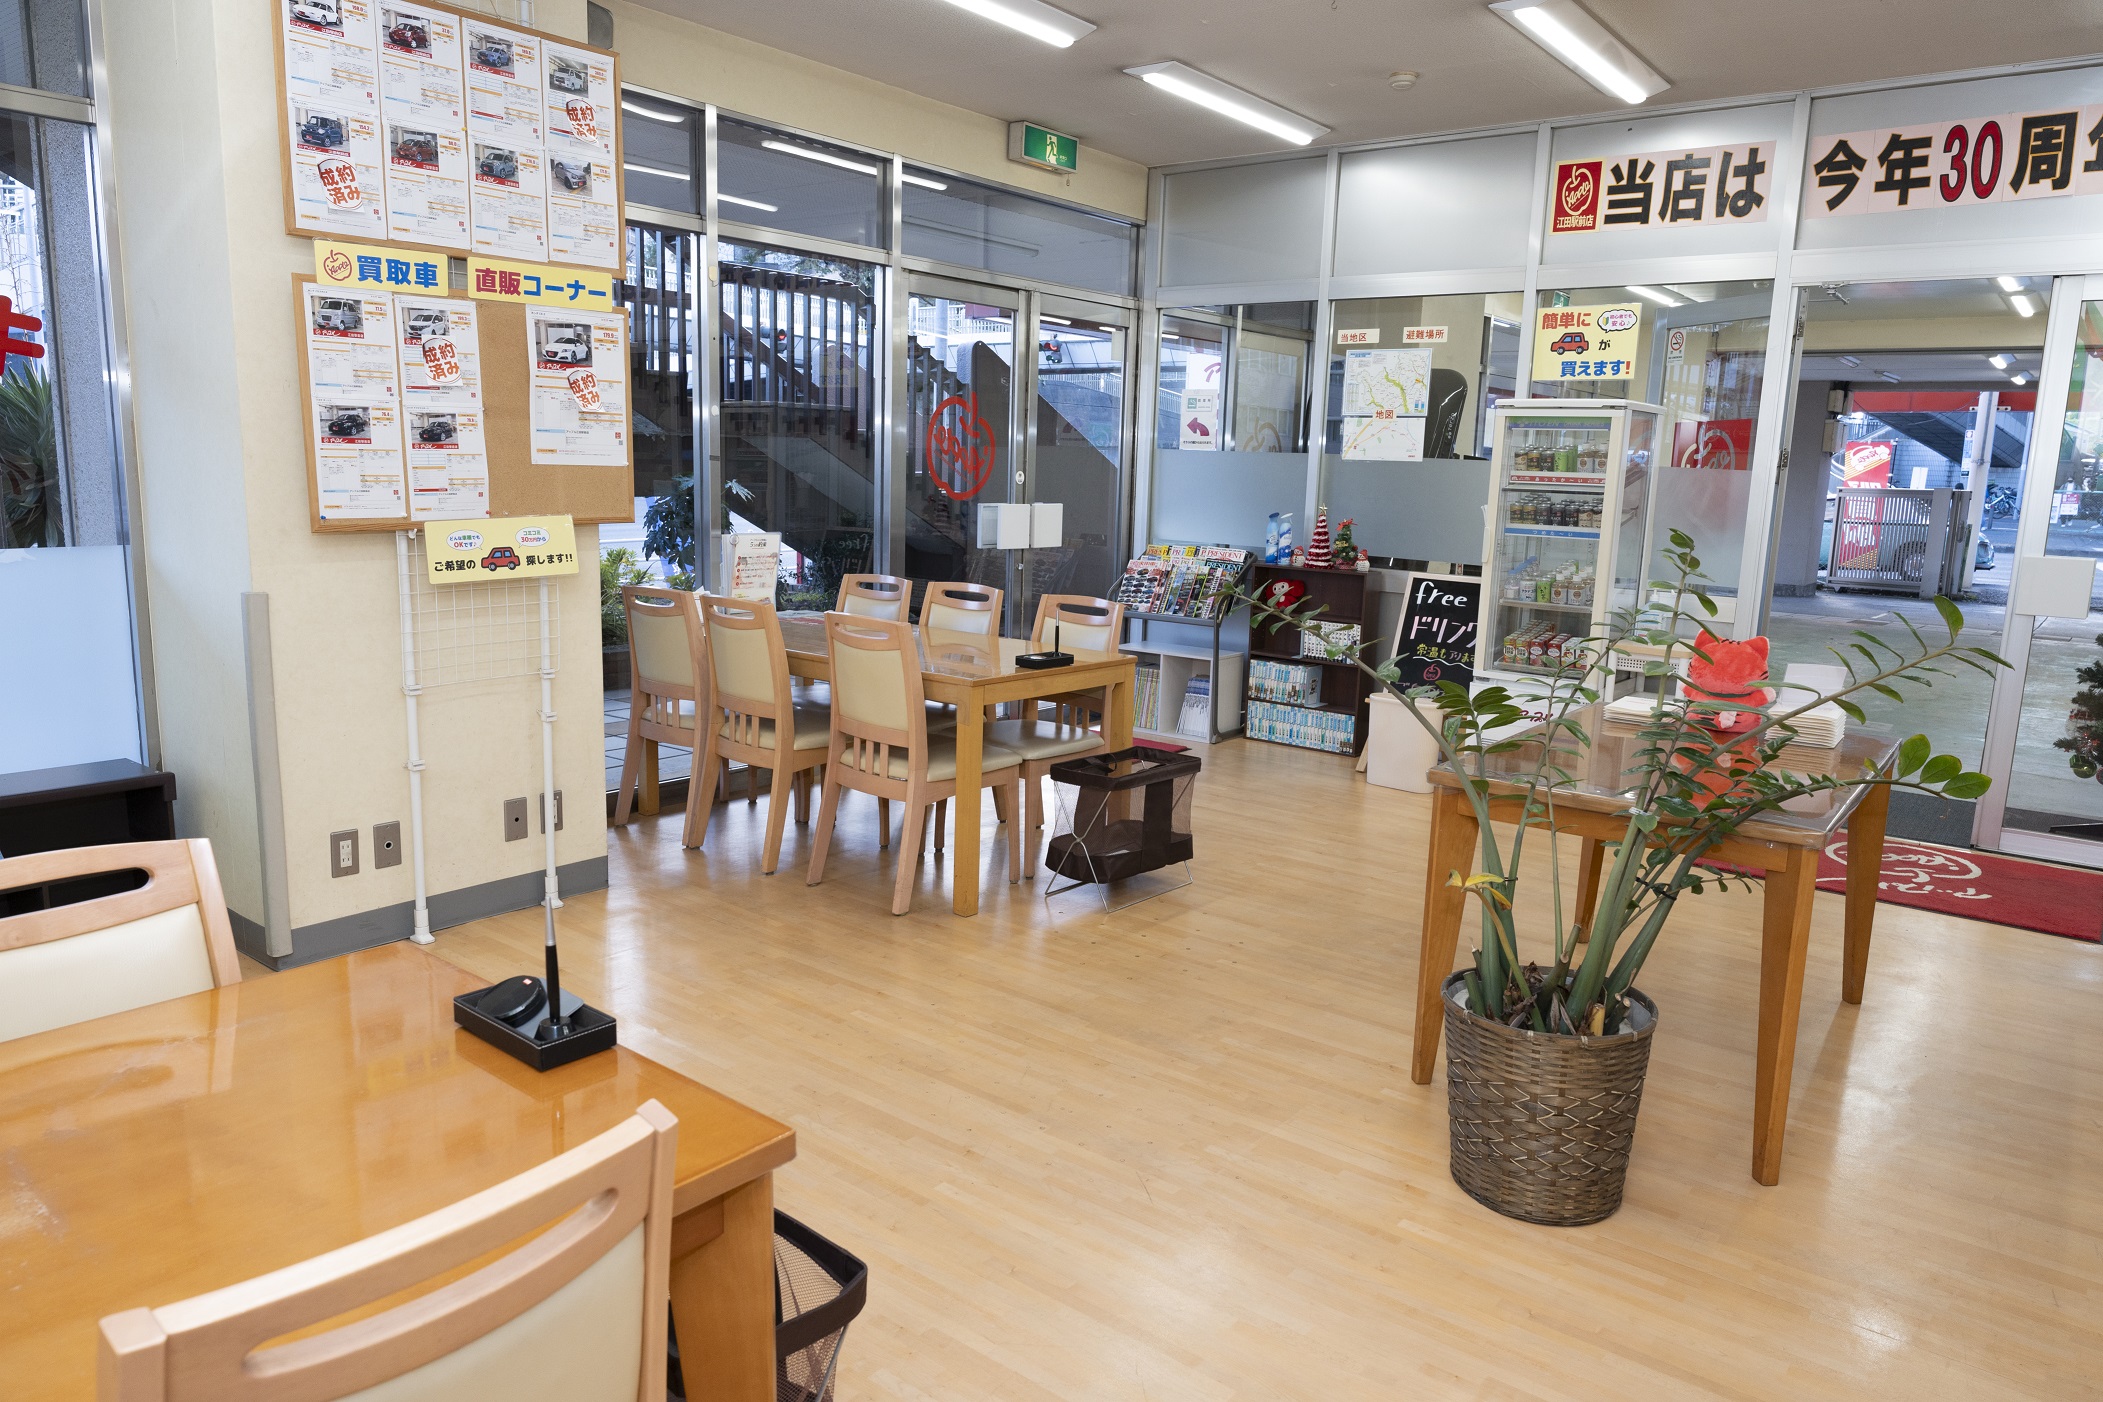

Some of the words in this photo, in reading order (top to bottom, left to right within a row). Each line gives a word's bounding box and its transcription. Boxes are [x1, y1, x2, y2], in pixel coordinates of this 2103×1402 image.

[567, 105, 595, 122] 成約
[571, 122, 597, 138] 済み
[320, 164, 356, 187] 成約
[326, 184, 361, 205] 済み
[1603, 147, 1767, 225] 当店は
[1556, 214, 1595, 228] 江田駅前店
[356, 254, 439, 288] 買取車
[475, 267, 607, 300] 直販コーナー
[1542, 312, 1591, 330] 簡単に
[1341, 332, 1367, 343] 当地区
[1405, 329, 1445, 340] 避難場所
[424, 342, 456, 364] 成約
[1598, 339, 1611, 351] が
[429, 361, 460, 380] 済み
[1560, 360, 1631, 378] 買えます!
[570, 373, 597, 395] 成約
[576, 390, 600, 408] 済み
[1375, 409, 1394, 420] 地図
[526, 553, 573, 566] 探します!!
[1207, 549, 1243, 559] PRESIDENT
[434, 559, 476, 572] ご希望の
[1415, 580, 1468, 607] free
[1409, 615, 1478, 648] ドリンク
